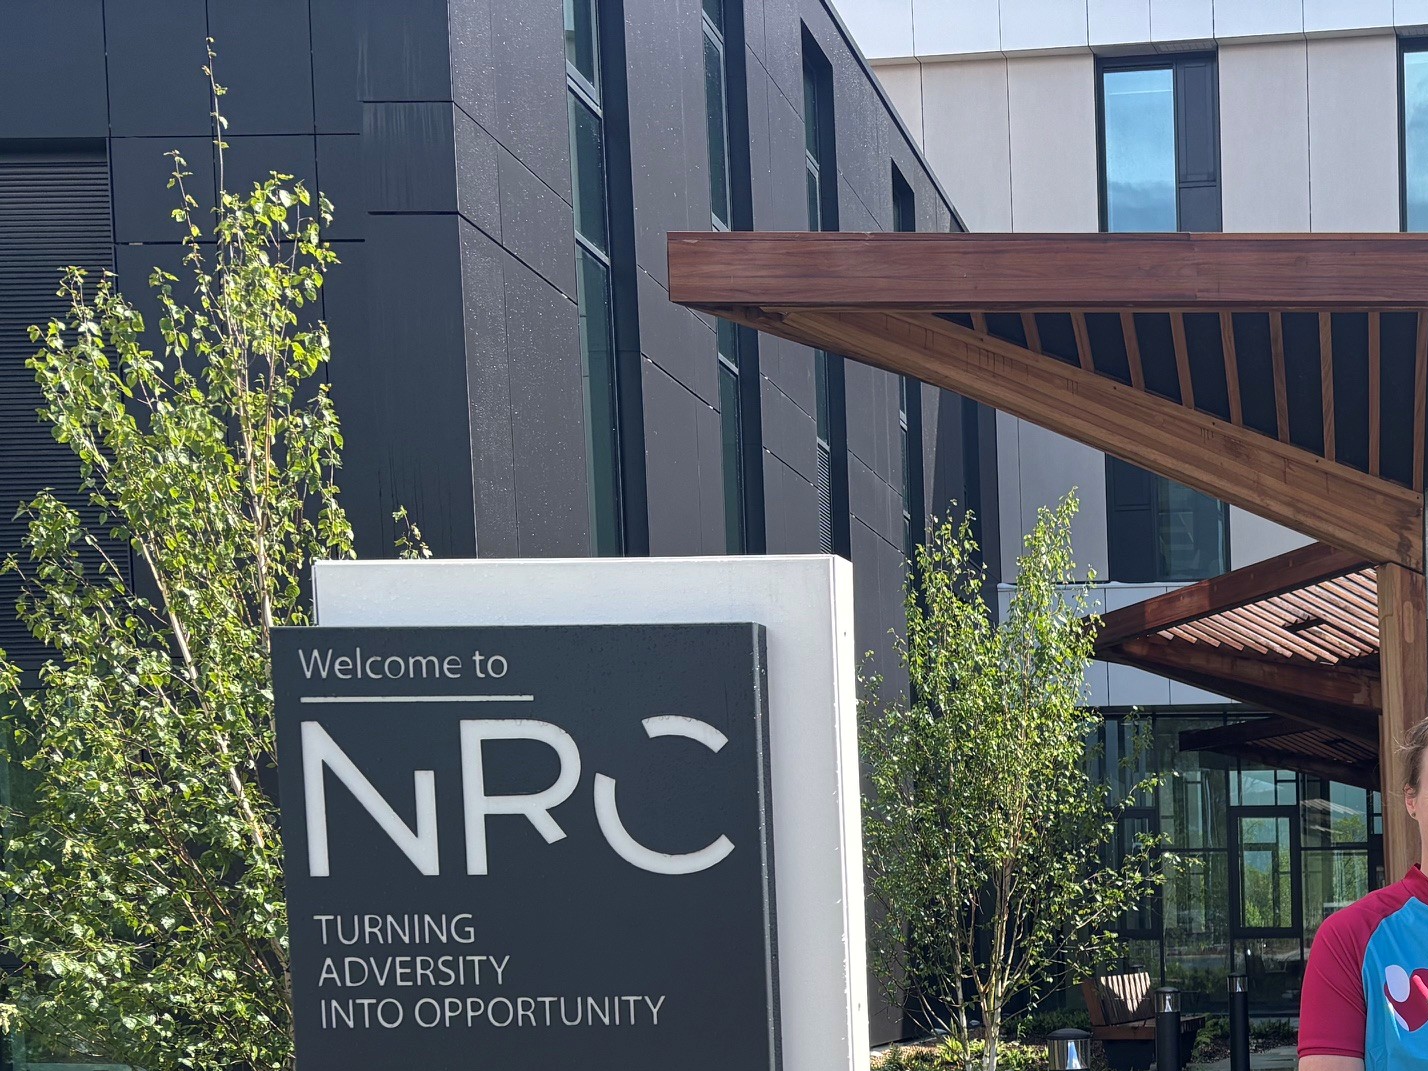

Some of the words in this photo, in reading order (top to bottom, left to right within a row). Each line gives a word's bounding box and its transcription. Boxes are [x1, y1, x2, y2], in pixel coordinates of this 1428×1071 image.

[298, 647, 463, 680] Welcome
[471, 650, 509, 679] to
[300, 714, 736, 878] NRC
[313, 913, 476, 946] TURNING
[318, 955, 511, 987] ADVERSITY
[320, 998, 404, 1029] INTO
[414, 995, 666, 1028] OPPORTUNITY
